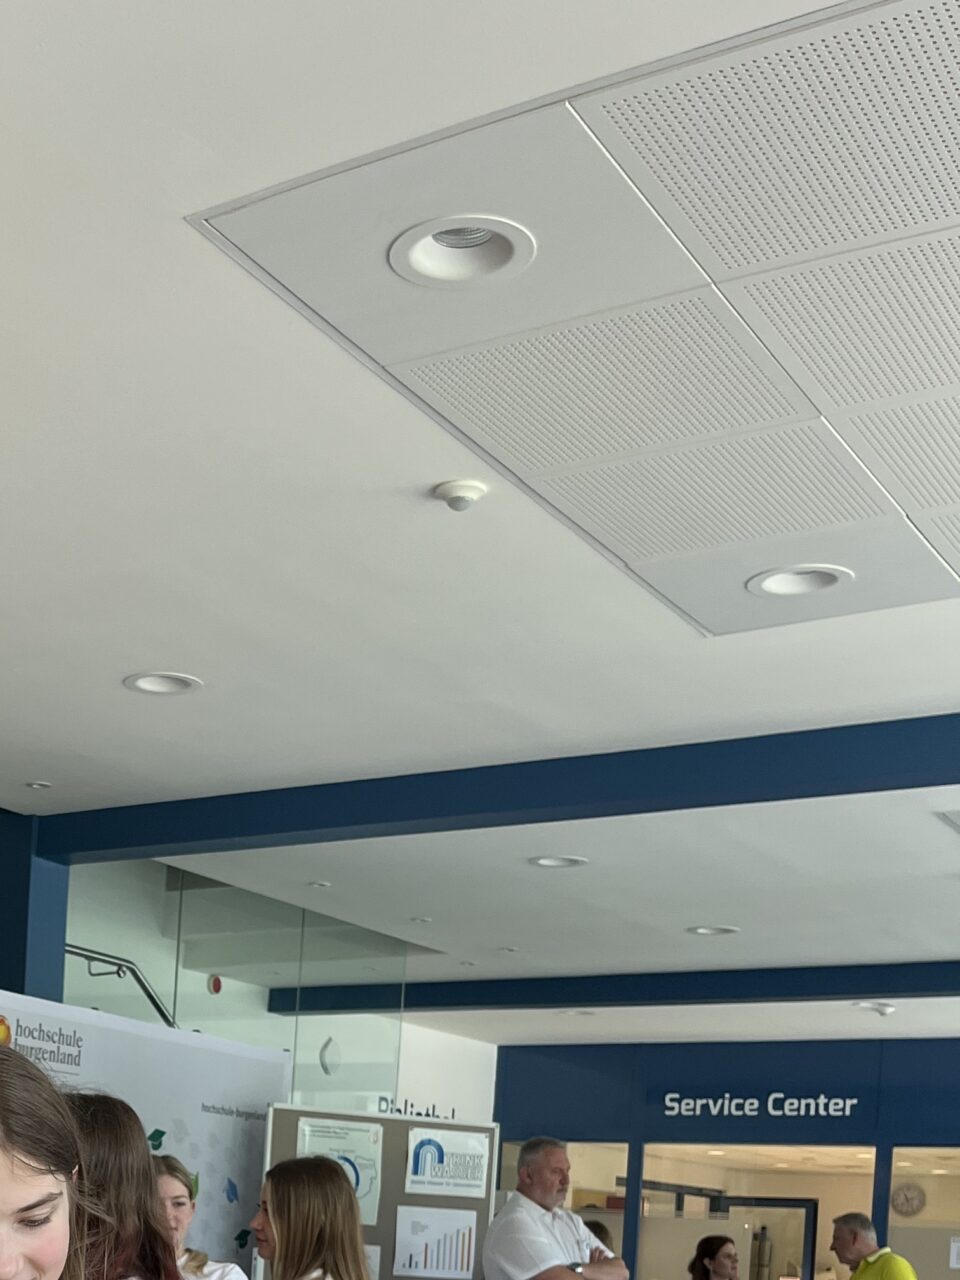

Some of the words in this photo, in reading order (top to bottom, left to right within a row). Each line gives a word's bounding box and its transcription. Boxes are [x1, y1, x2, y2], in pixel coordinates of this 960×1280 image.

[15, 1018, 83, 1048] hochschule
[14, 1038, 82, 1067] burgenland
[377, 1096, 455, 1120] Biblith
[664, 1092, 759, 1116] Service
[767, 1092, 858, 1116] Center
